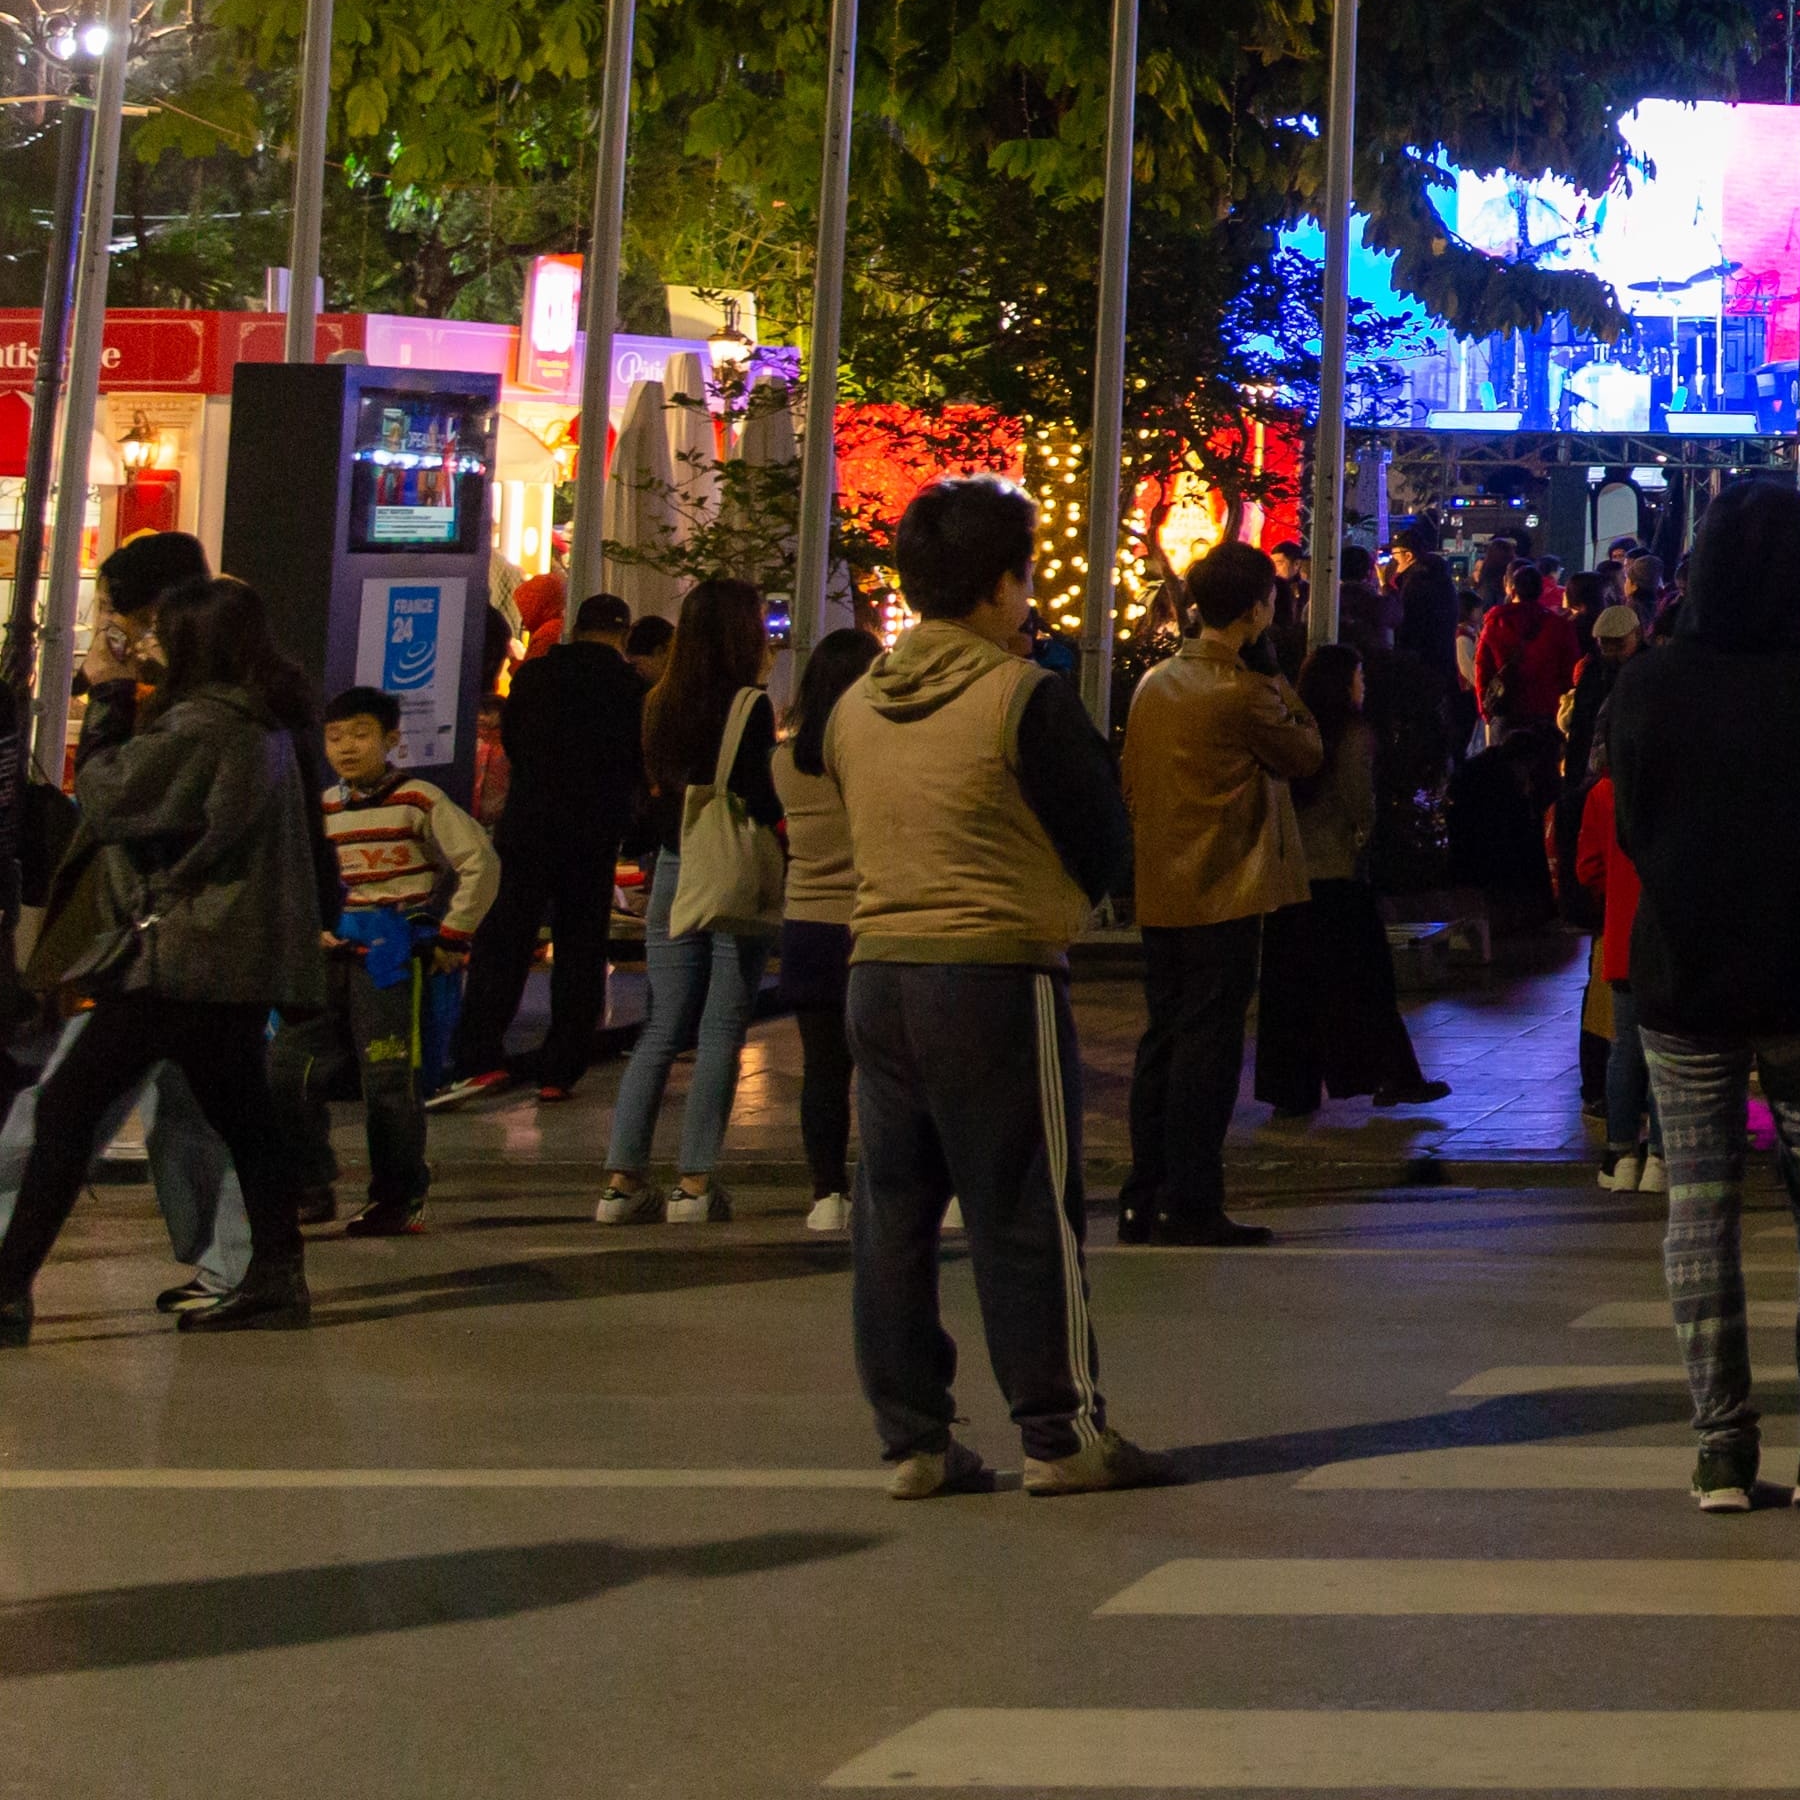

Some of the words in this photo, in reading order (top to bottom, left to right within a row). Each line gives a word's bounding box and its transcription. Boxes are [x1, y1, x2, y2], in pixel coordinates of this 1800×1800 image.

[393, 598, 435, 614] FRANCE
[391, 615, 413, 644] 24
[360, 845, 411, 869] Y-3
